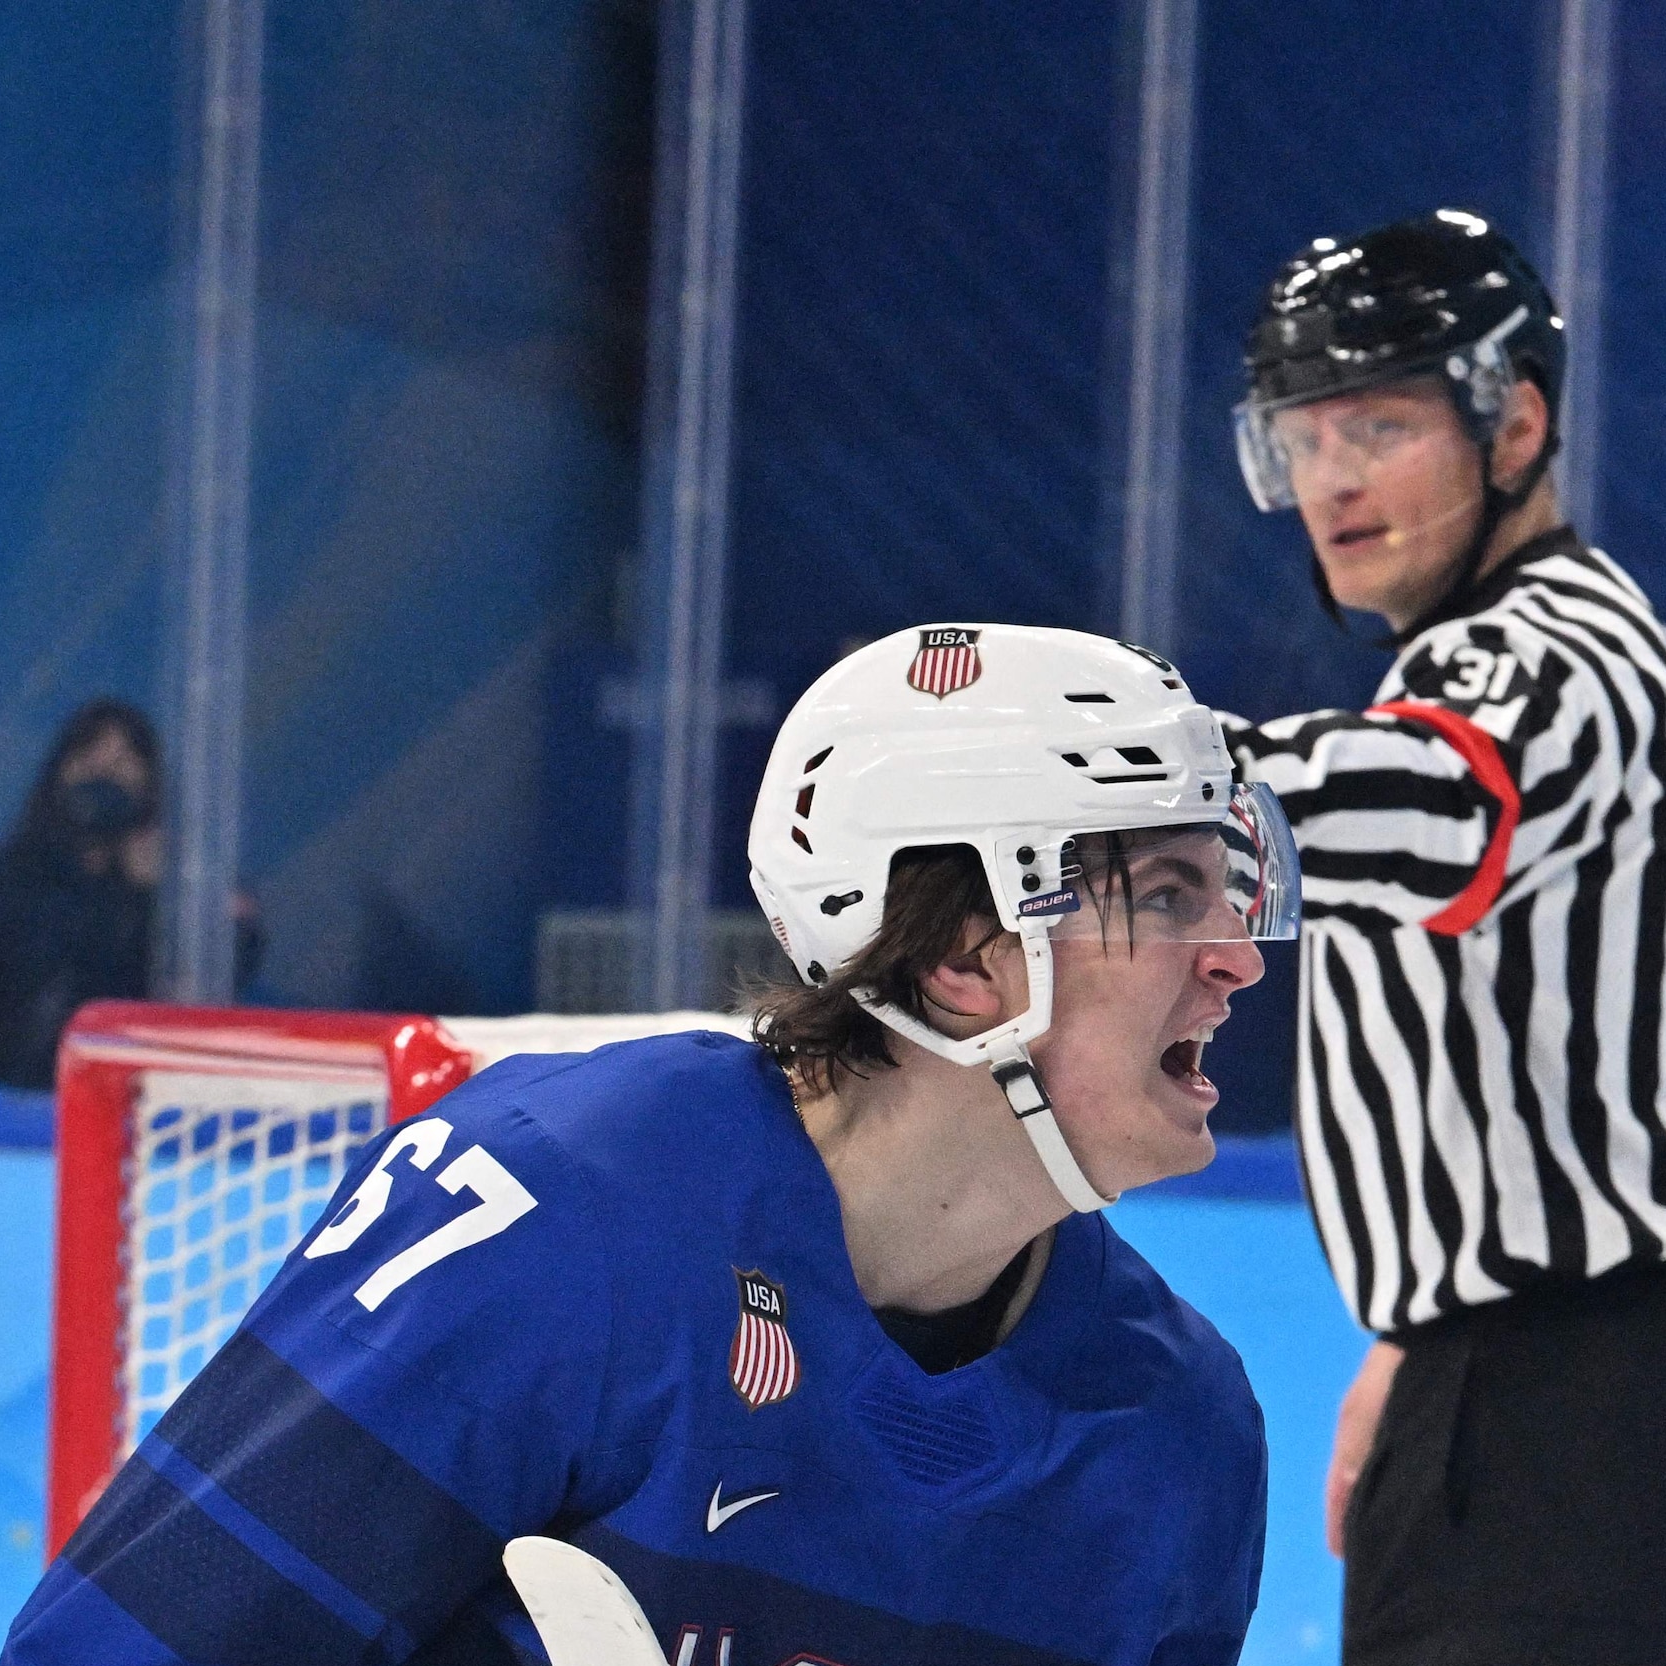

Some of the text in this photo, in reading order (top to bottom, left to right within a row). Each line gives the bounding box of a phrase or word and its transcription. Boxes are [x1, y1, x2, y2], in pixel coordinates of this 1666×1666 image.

[927, 632, 970, 647] USA
[1441, 646, 1517, 701] 31
[1021, 891, 1075, 913] BAUER
[303, 1116, 539, 1312] 67
[745, 1280, 782, 1317] USA
